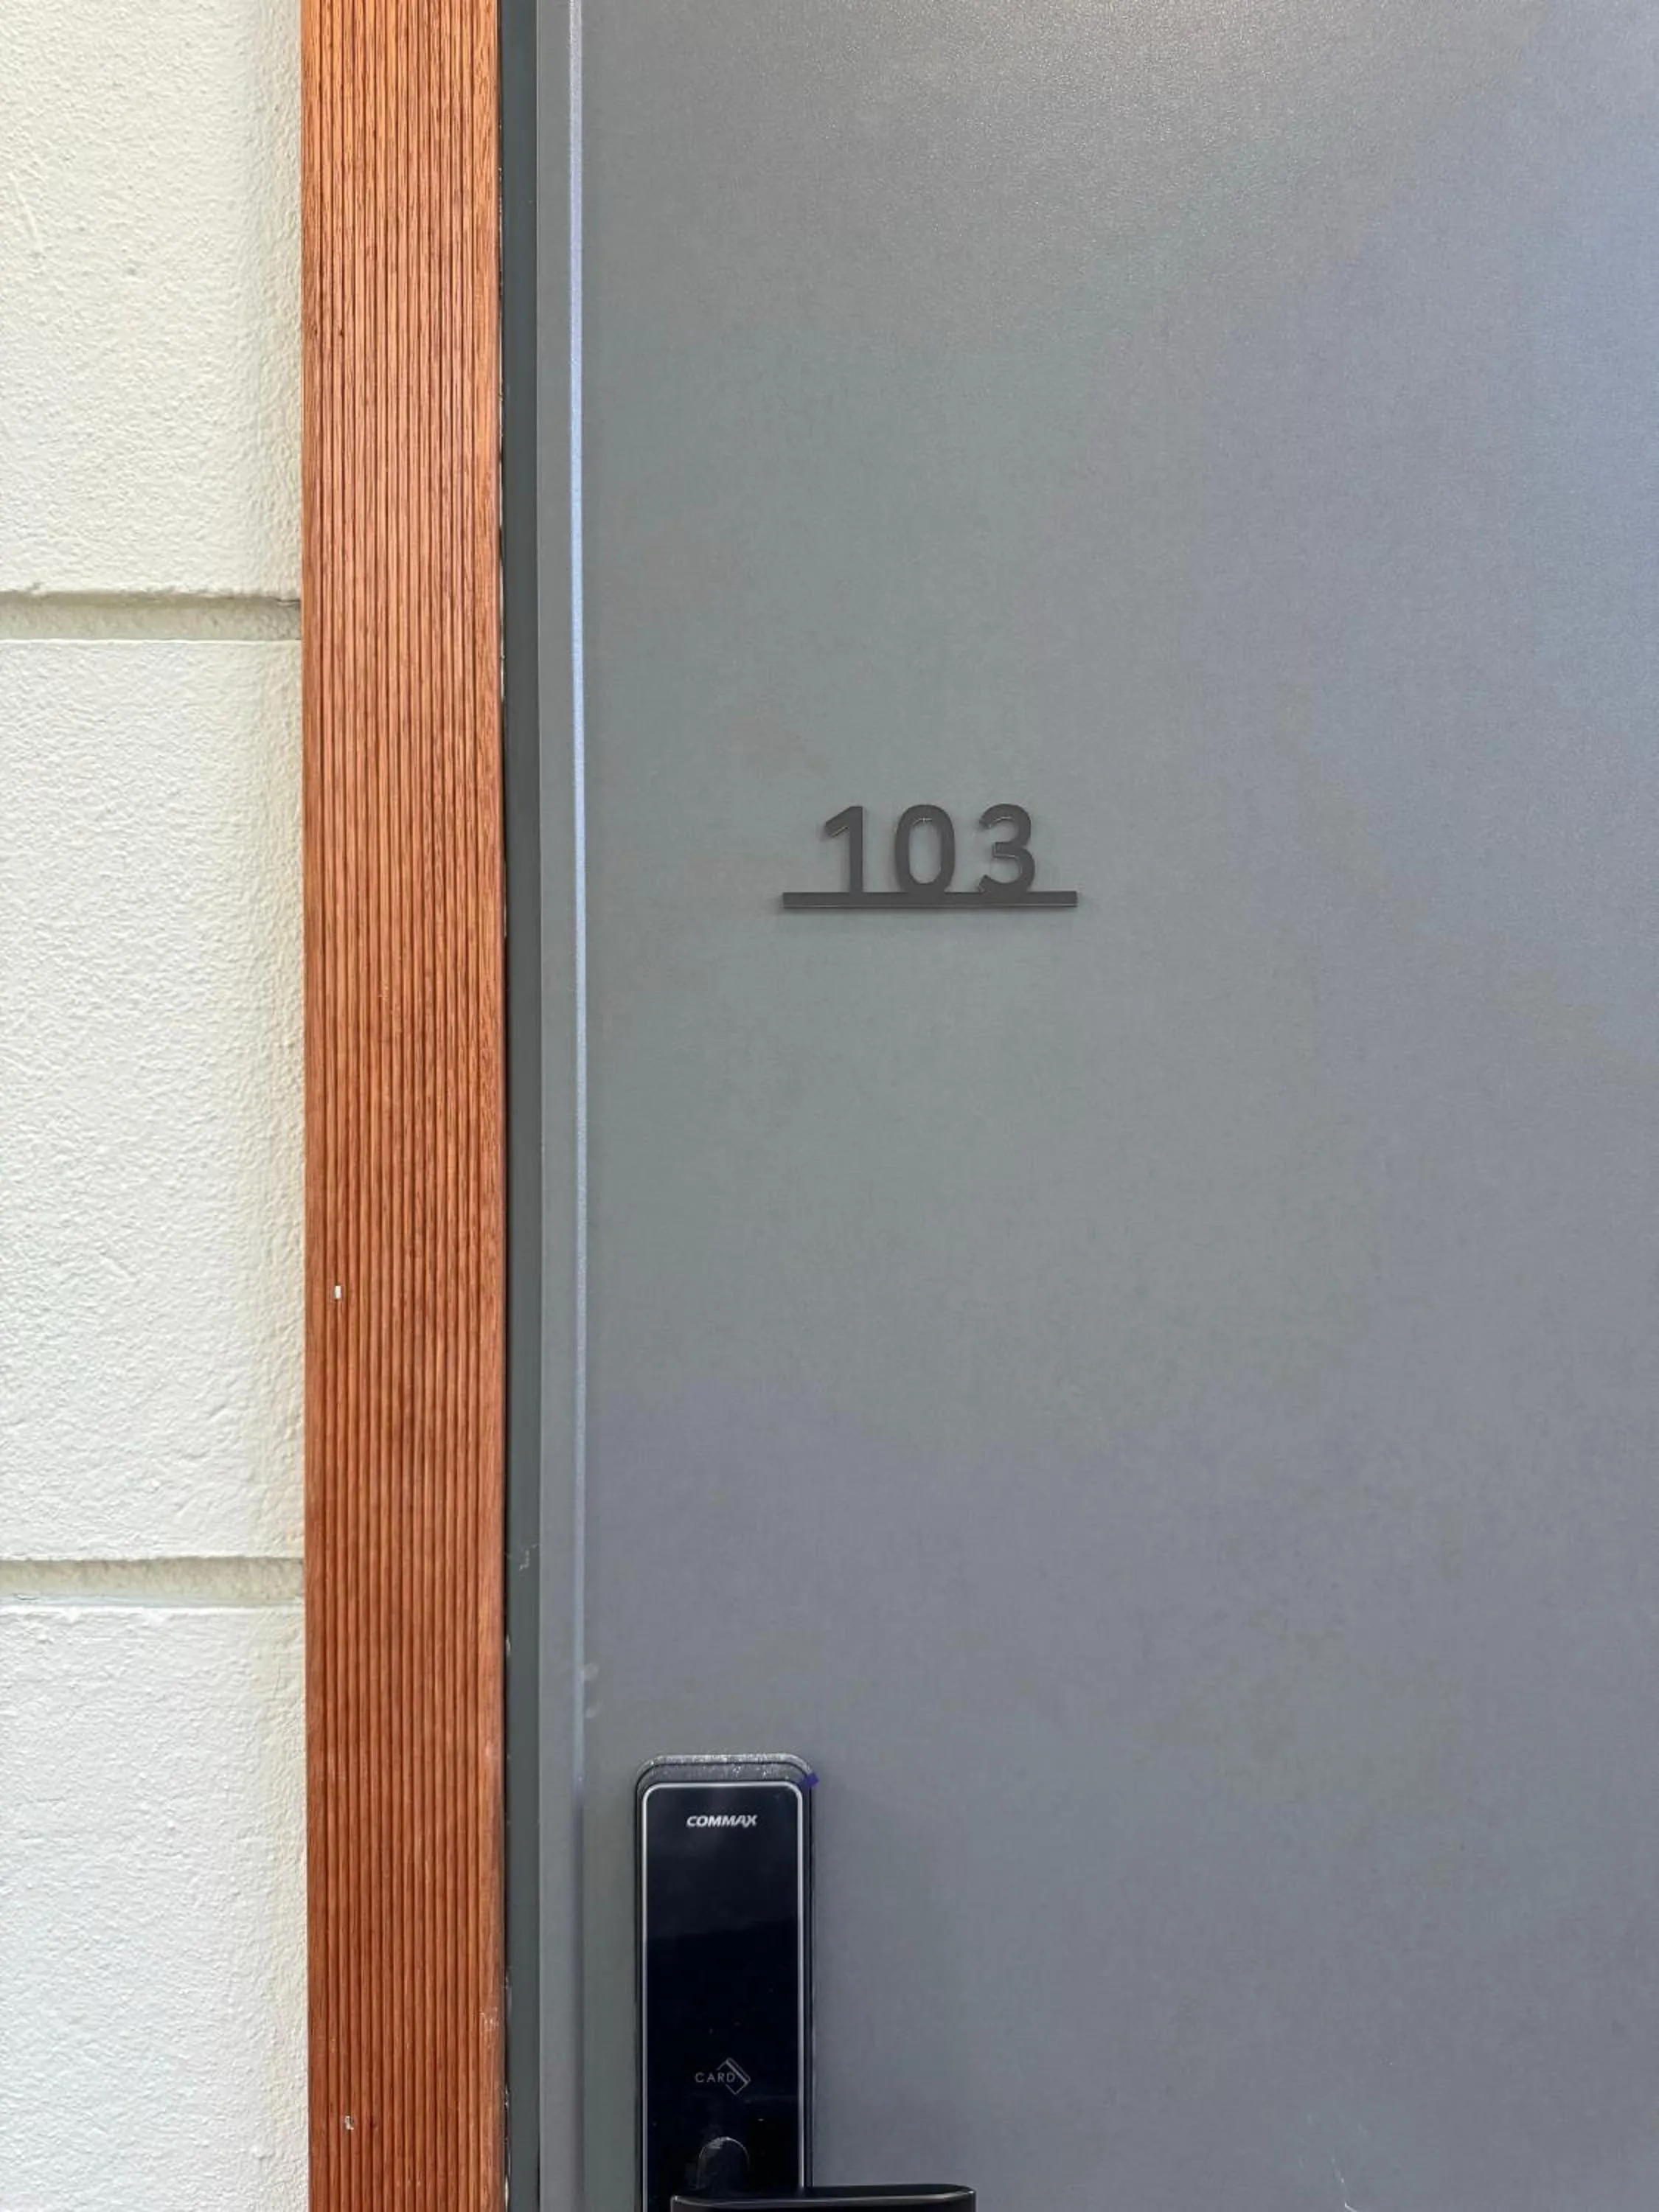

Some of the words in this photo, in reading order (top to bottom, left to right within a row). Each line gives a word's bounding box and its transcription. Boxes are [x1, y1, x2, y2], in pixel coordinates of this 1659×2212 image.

[824, 803, 1035, 896] 103
[686, 1815, 758, 1828] COMMAX
[695, 2071, 736, 2083] CARD
